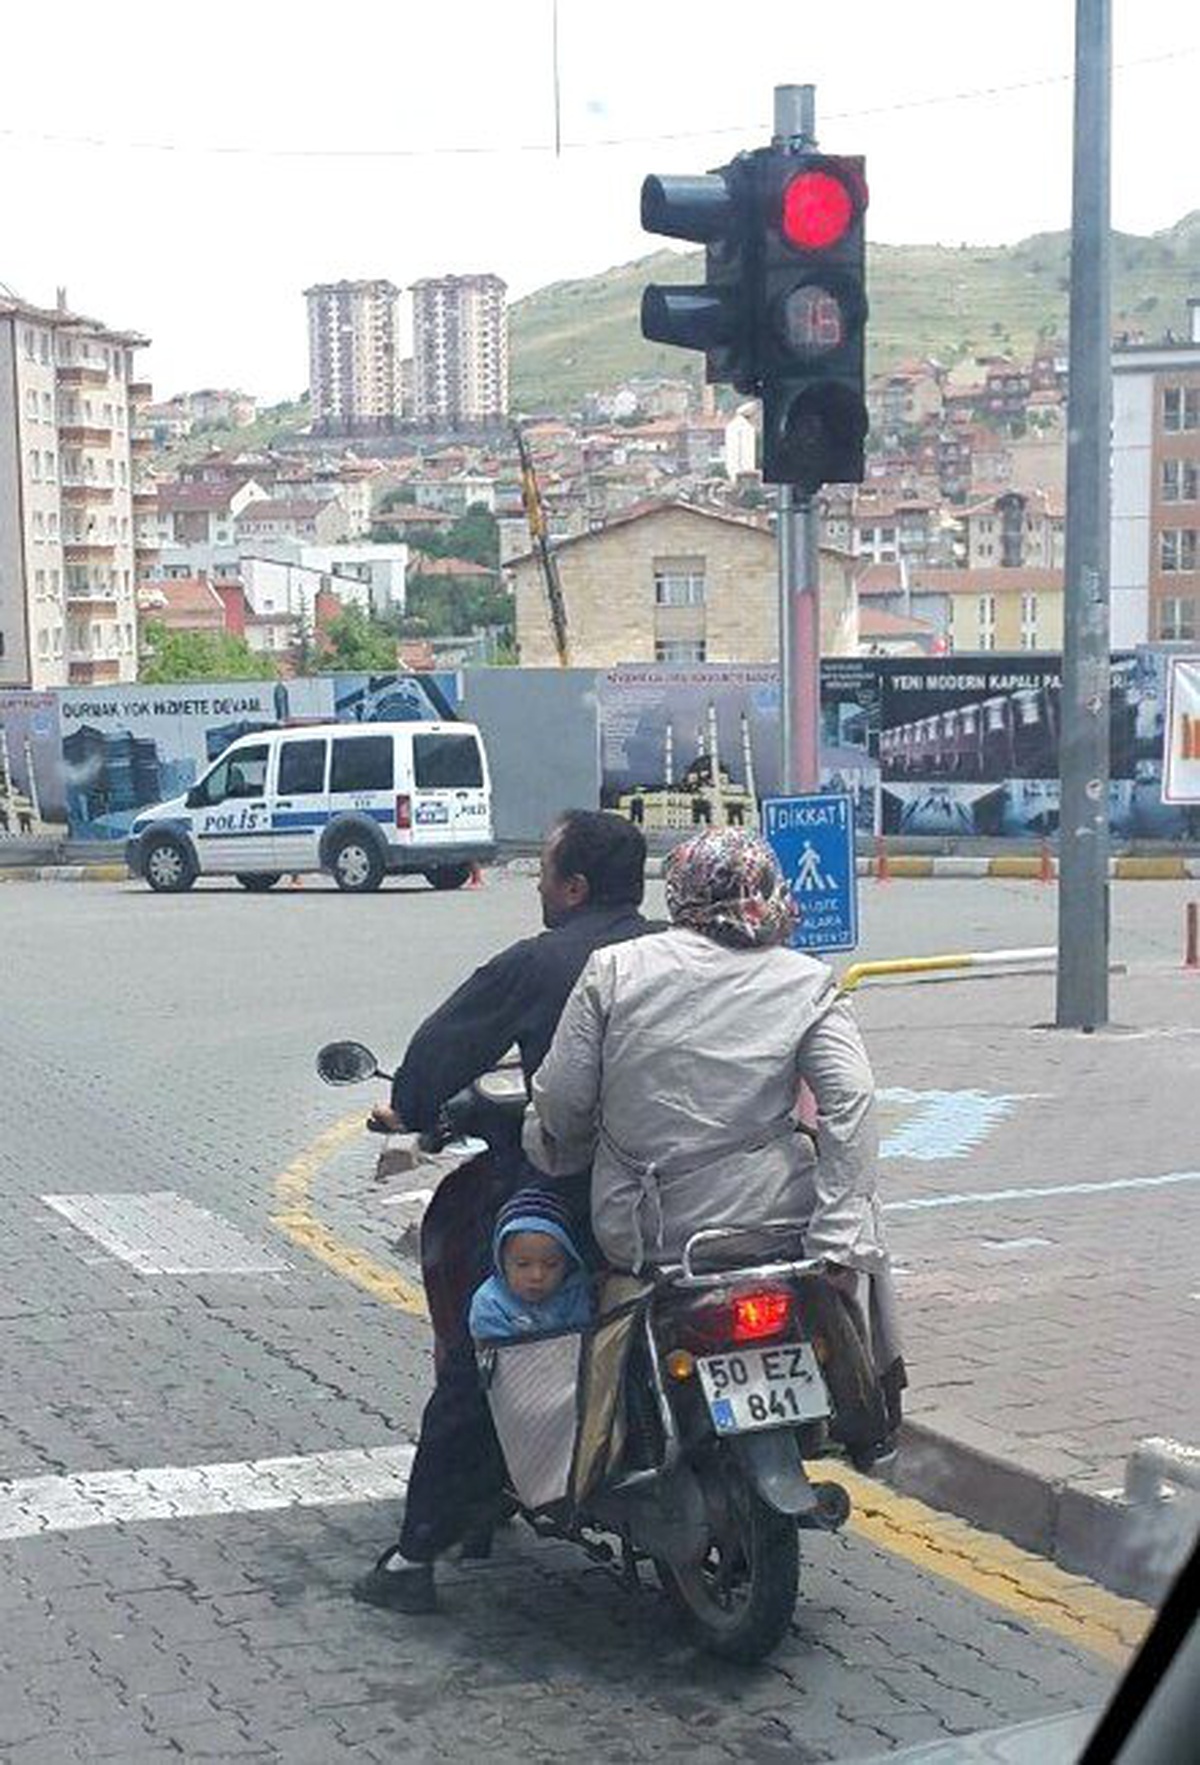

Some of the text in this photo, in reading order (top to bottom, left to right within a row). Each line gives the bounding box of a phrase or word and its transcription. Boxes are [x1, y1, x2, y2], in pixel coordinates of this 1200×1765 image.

[926, 674, 985, 690] MODERN
[989, 674, 1040, 688] KAPALI
[62, 702, 118, 719] DURMAK
[118, 701, 150, 716] YOK
[203, 808, 257, 831] POLİS
[708, 1348, 808, 1388] 50 EZ
[747, 1387, 800, 1421] 841
